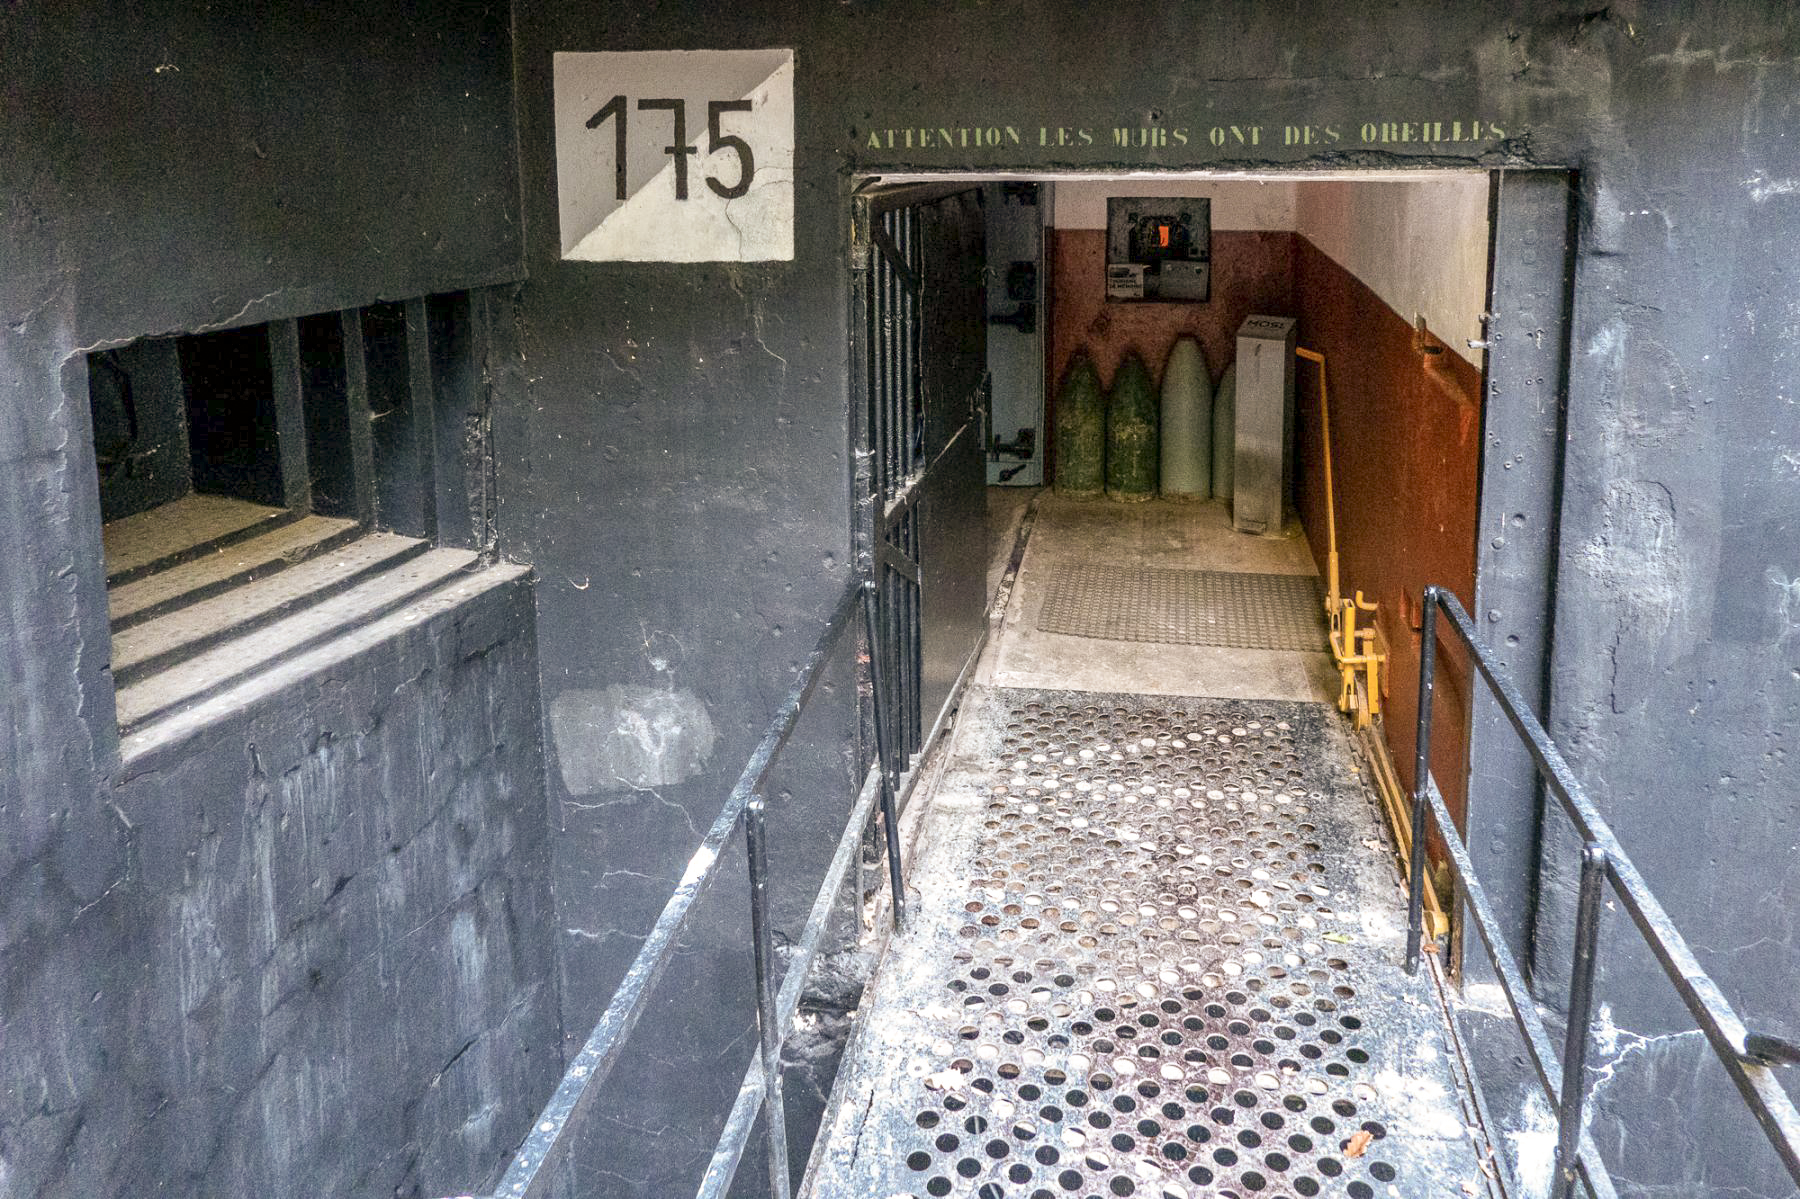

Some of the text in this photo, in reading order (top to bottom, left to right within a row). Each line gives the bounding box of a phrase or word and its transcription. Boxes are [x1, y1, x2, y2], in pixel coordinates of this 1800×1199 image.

[585, 95, 754, 200] 175
[866, 120, 1506, 148] ATTENTION LES MURS ONT DES OREILLES
